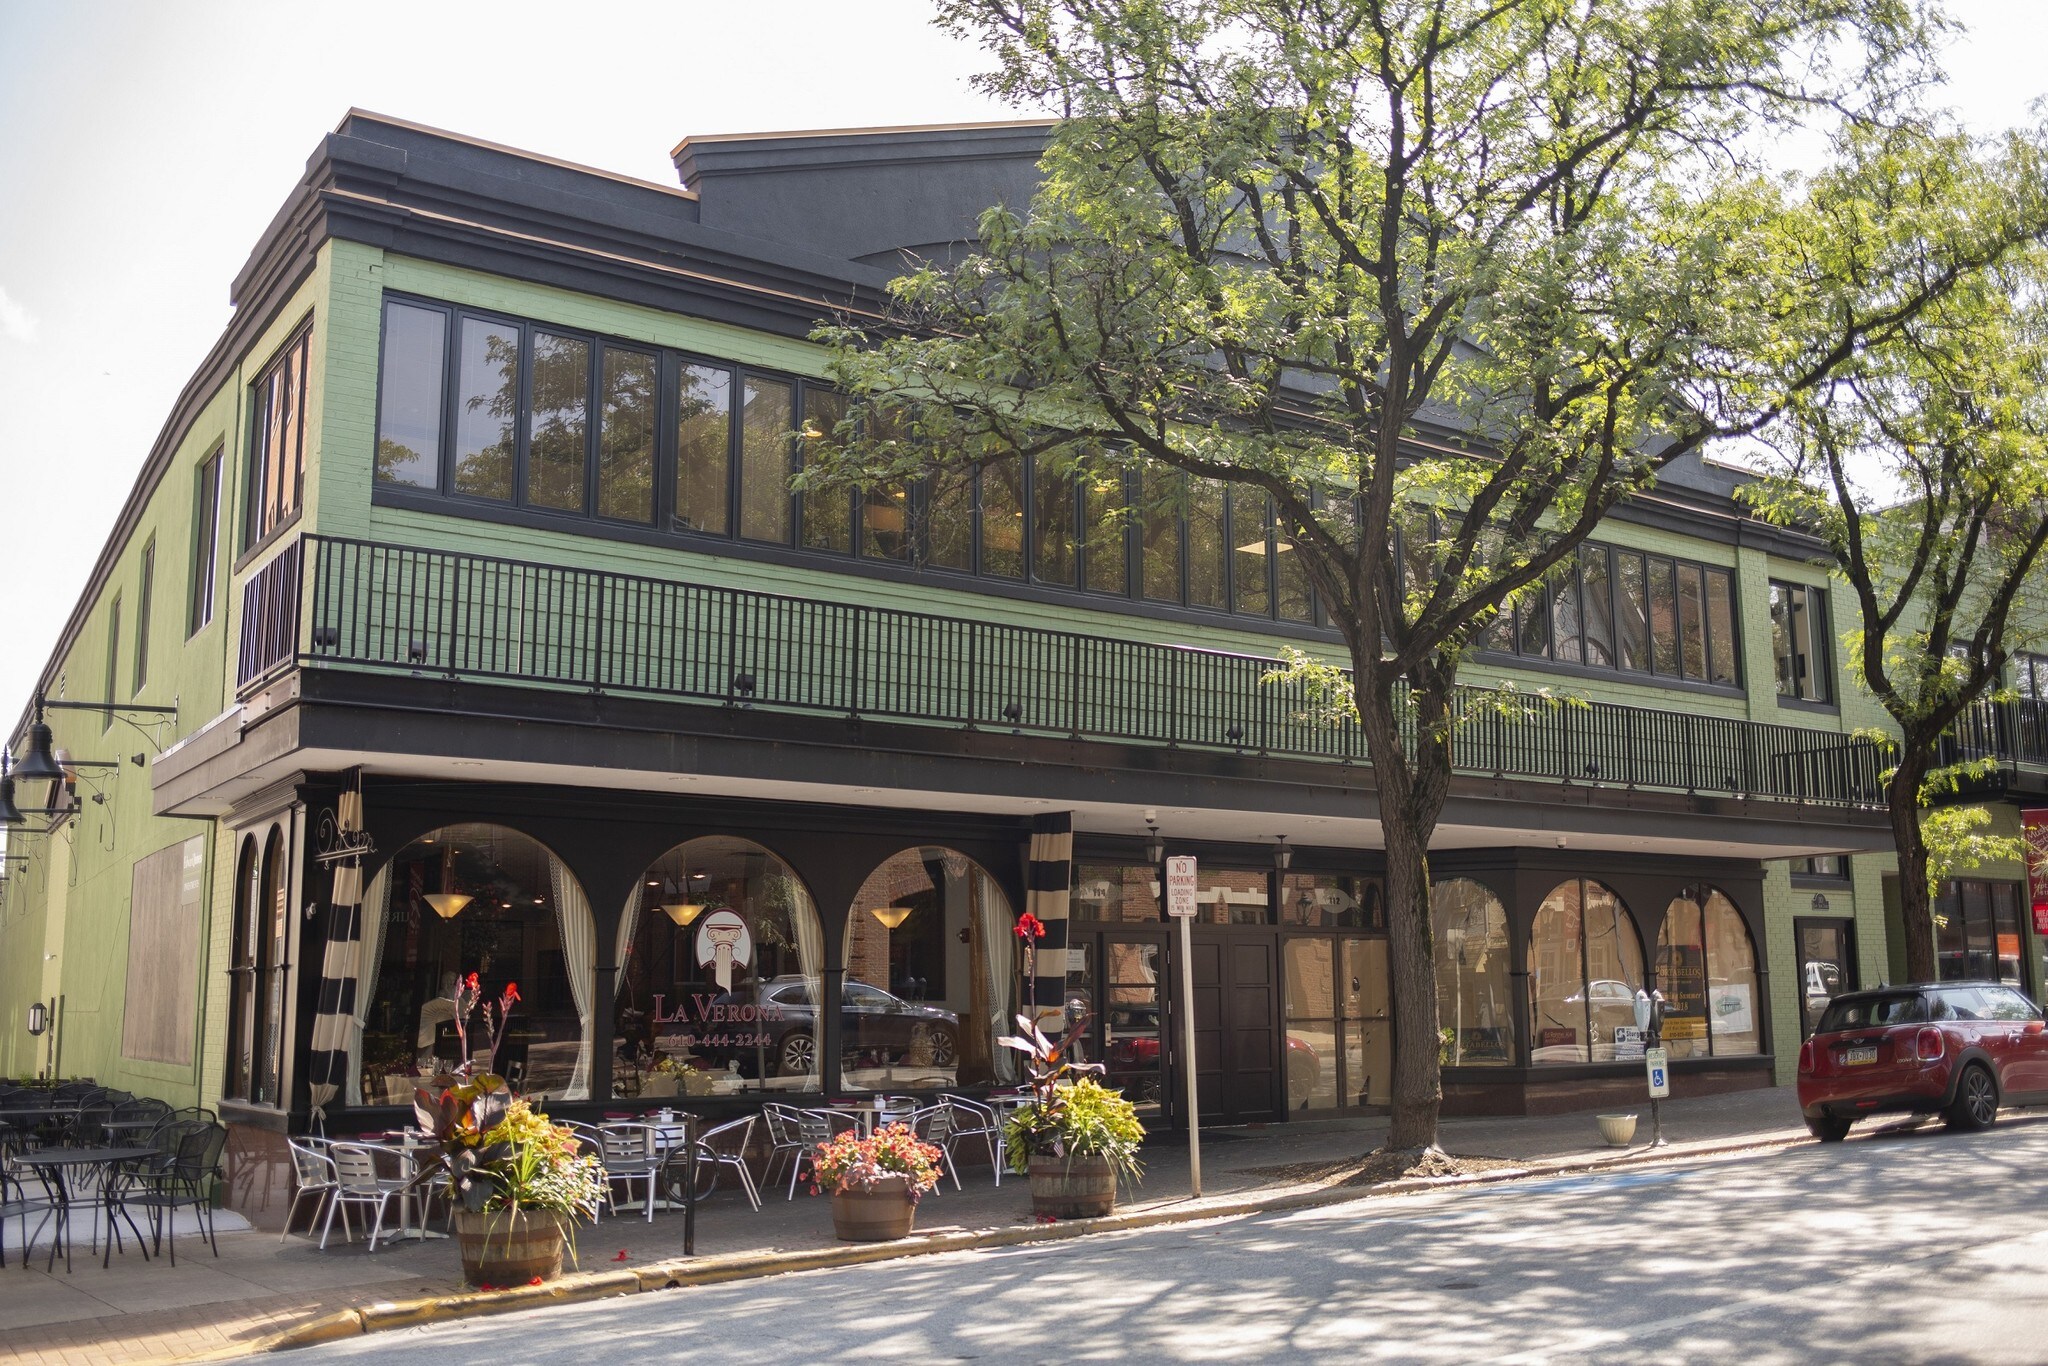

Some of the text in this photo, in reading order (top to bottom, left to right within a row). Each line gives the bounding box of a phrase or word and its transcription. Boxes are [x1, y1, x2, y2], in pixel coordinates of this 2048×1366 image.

[1176, 862, 1187, 873] NO
[1169, 875, 1195, 886] PARKING
[1171, 888, 1193, 896] LOADING
[1329, 897, 1340, 905] 112
[691, 993, 785, 1023] VERONA
[668, 1033, 772, 1048] 610-444-2244
